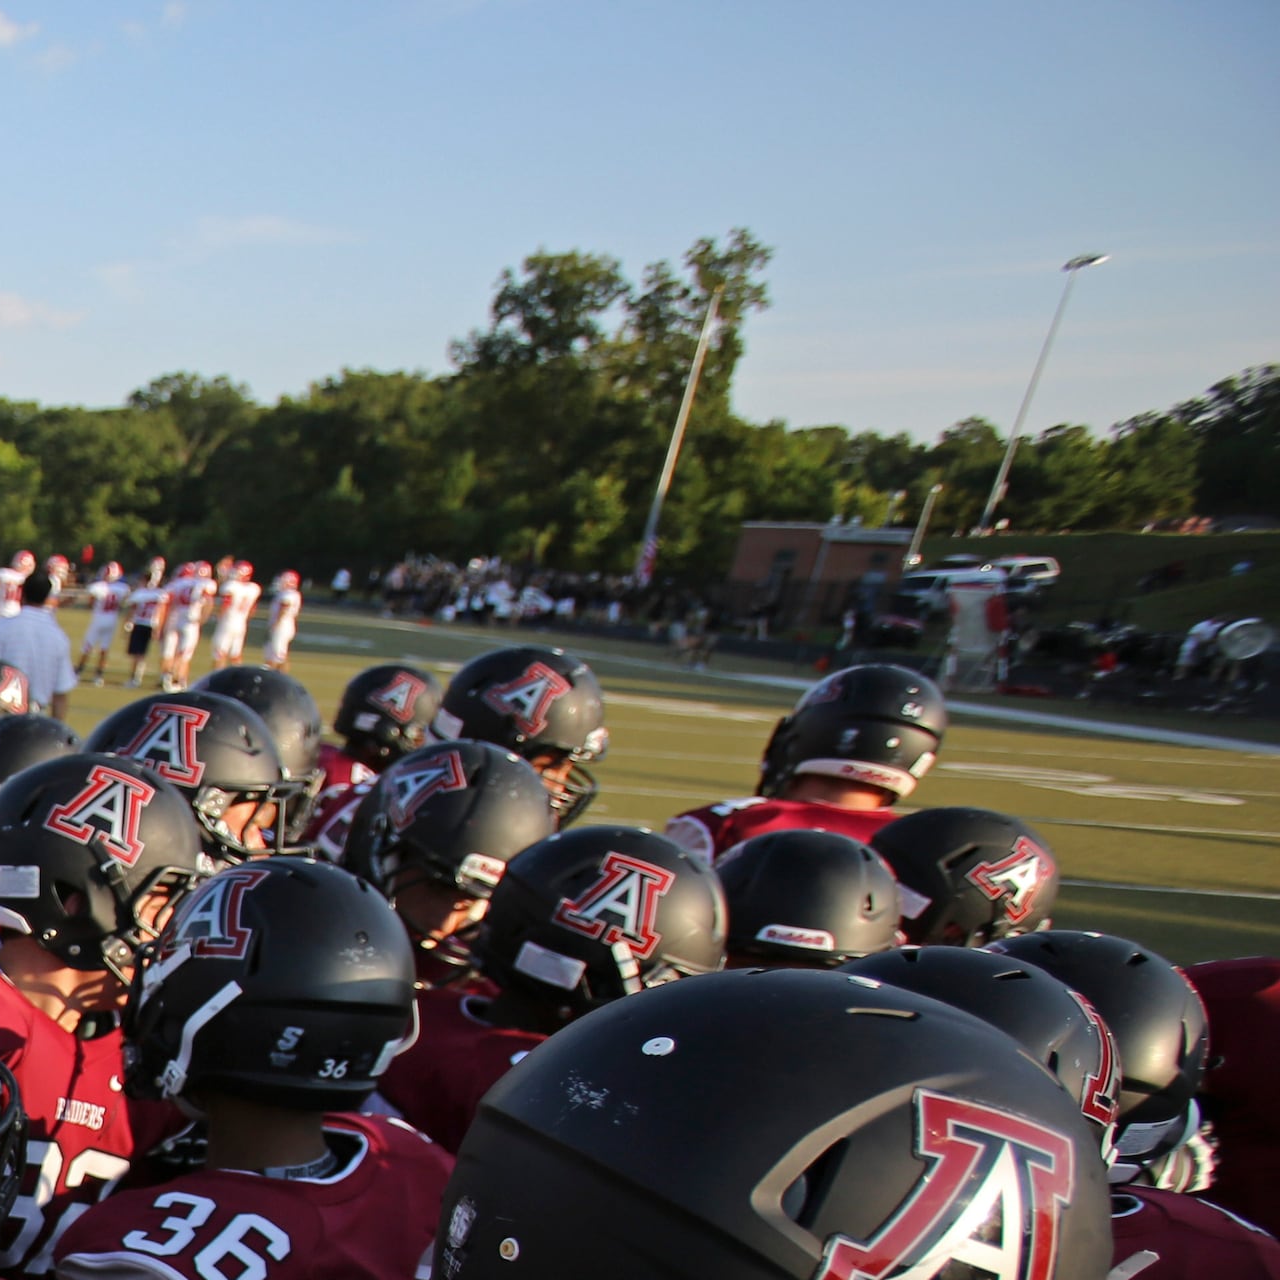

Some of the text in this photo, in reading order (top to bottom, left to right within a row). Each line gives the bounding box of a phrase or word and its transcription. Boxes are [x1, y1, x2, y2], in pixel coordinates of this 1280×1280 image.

[372, 670, 428, 723] A
[487, 661, 572, 739] A
[116, 702, 211, 789] A
[44, 764, 155, 868] A
[390, 750, 468, 831] A
[160, 867, 272, 960] A
[553, 851, 677, 959] A
[966, 835, 1056, 923] A
[318, 1058, 350, 1079] 36
[54, 1096, 106, 1131] RAIDERS
